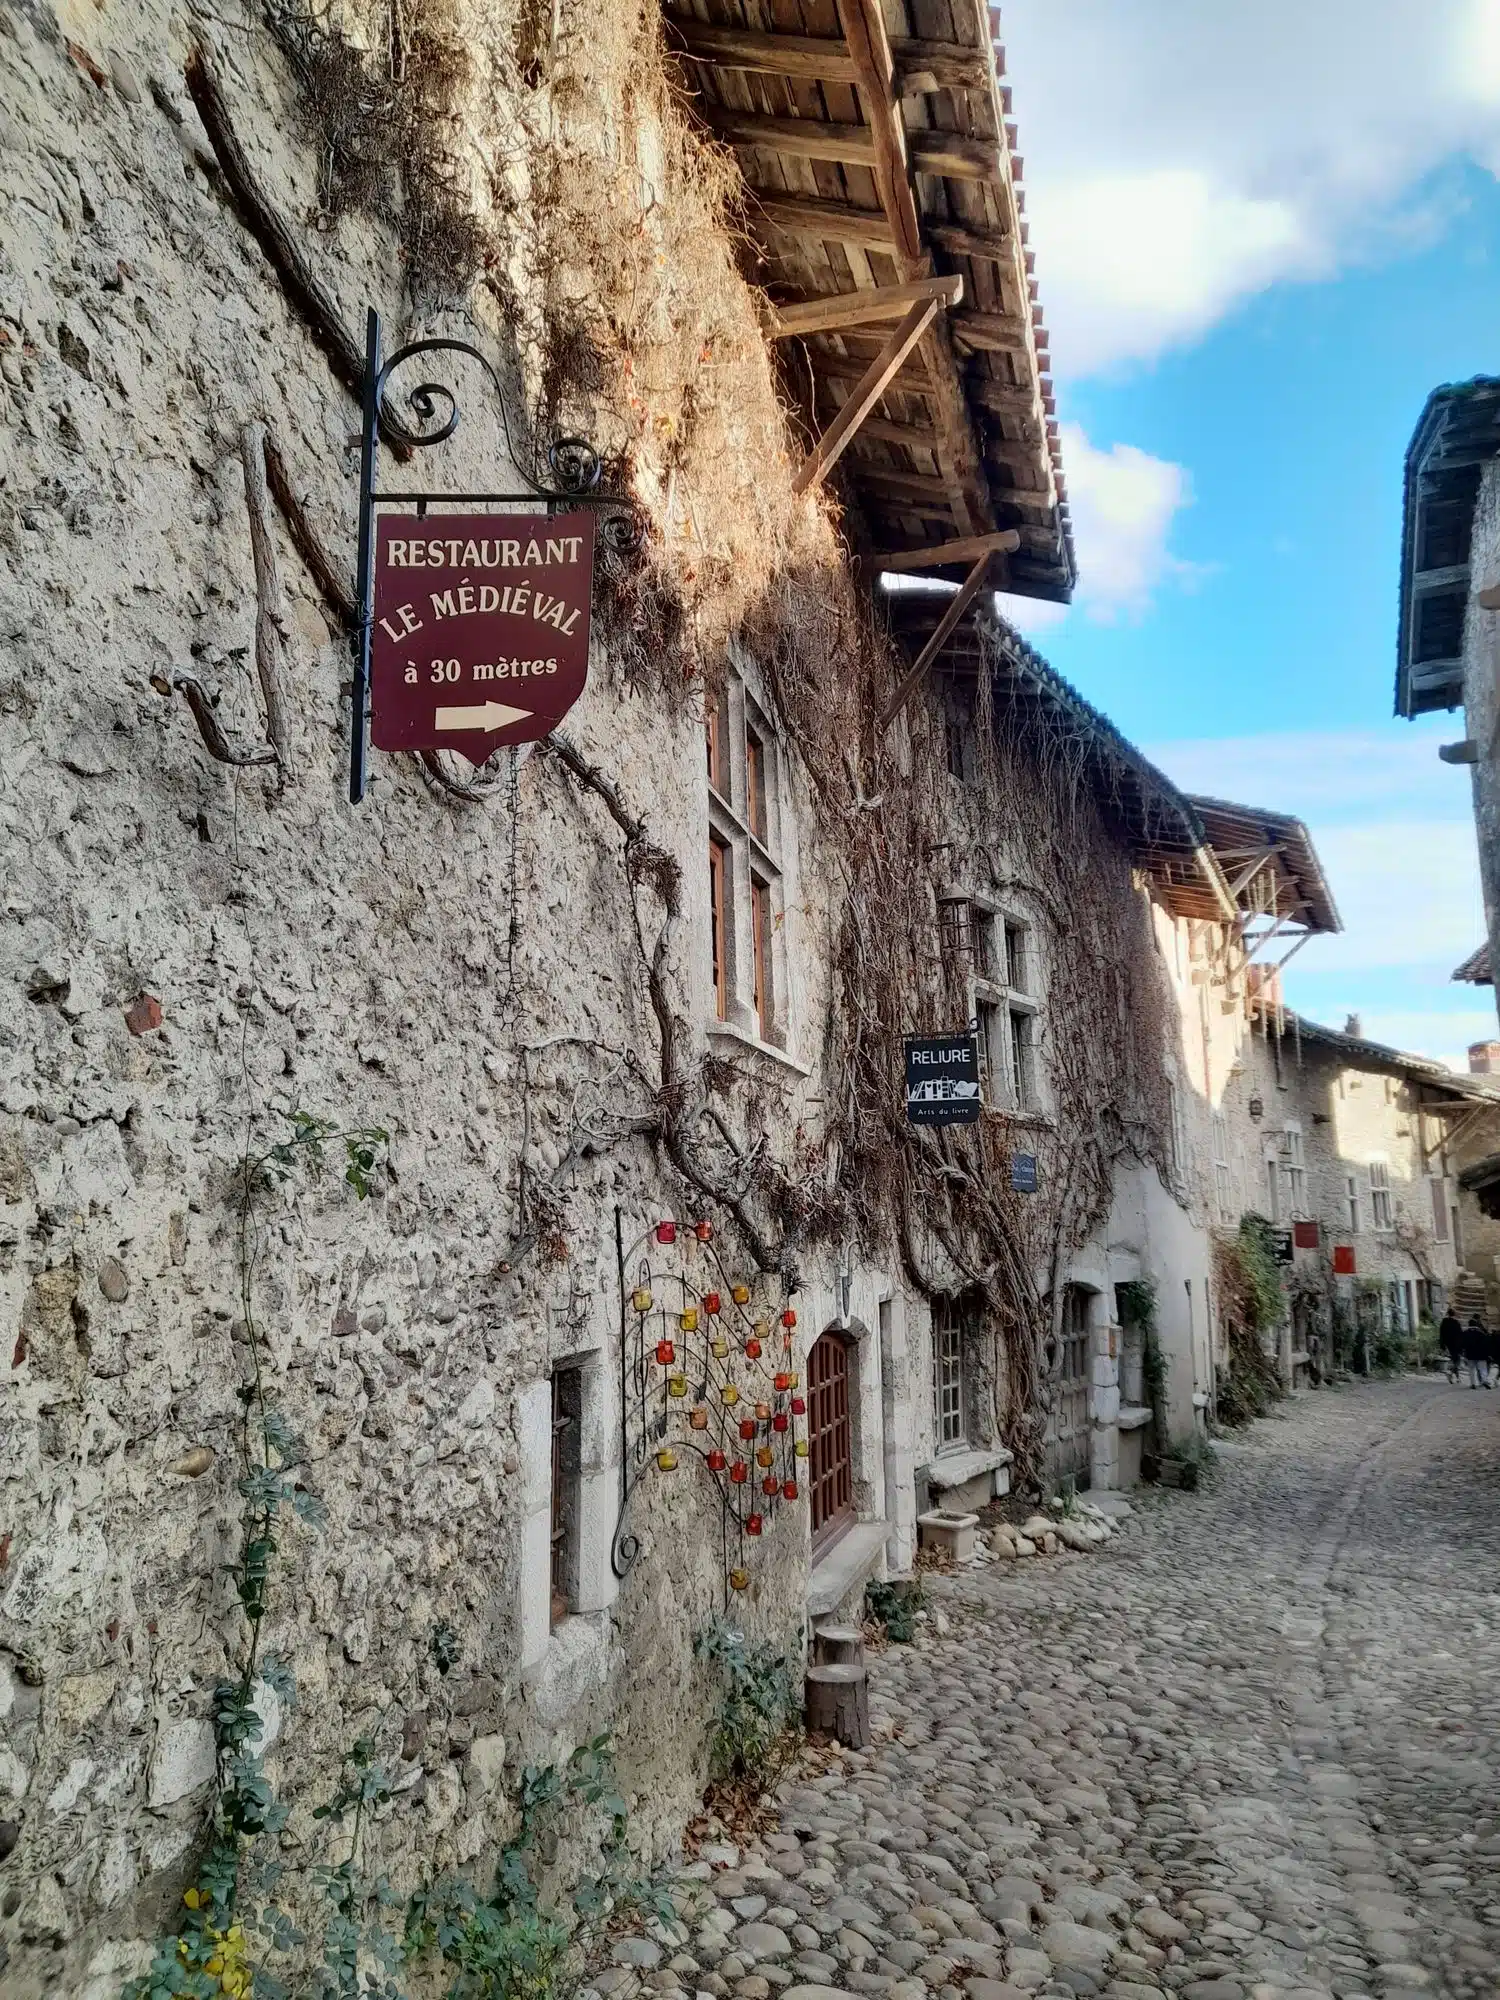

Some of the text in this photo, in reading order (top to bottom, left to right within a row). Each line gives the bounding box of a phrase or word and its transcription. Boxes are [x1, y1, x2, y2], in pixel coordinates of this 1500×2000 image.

[387, 536, 583, 567] RESTAURANT
[378, 577, 582, 643] LE MÉDIÉVAL
[404, 656, 558, 684] à 30 mètres
[912, 1049, 971, 1065] RELIURE
